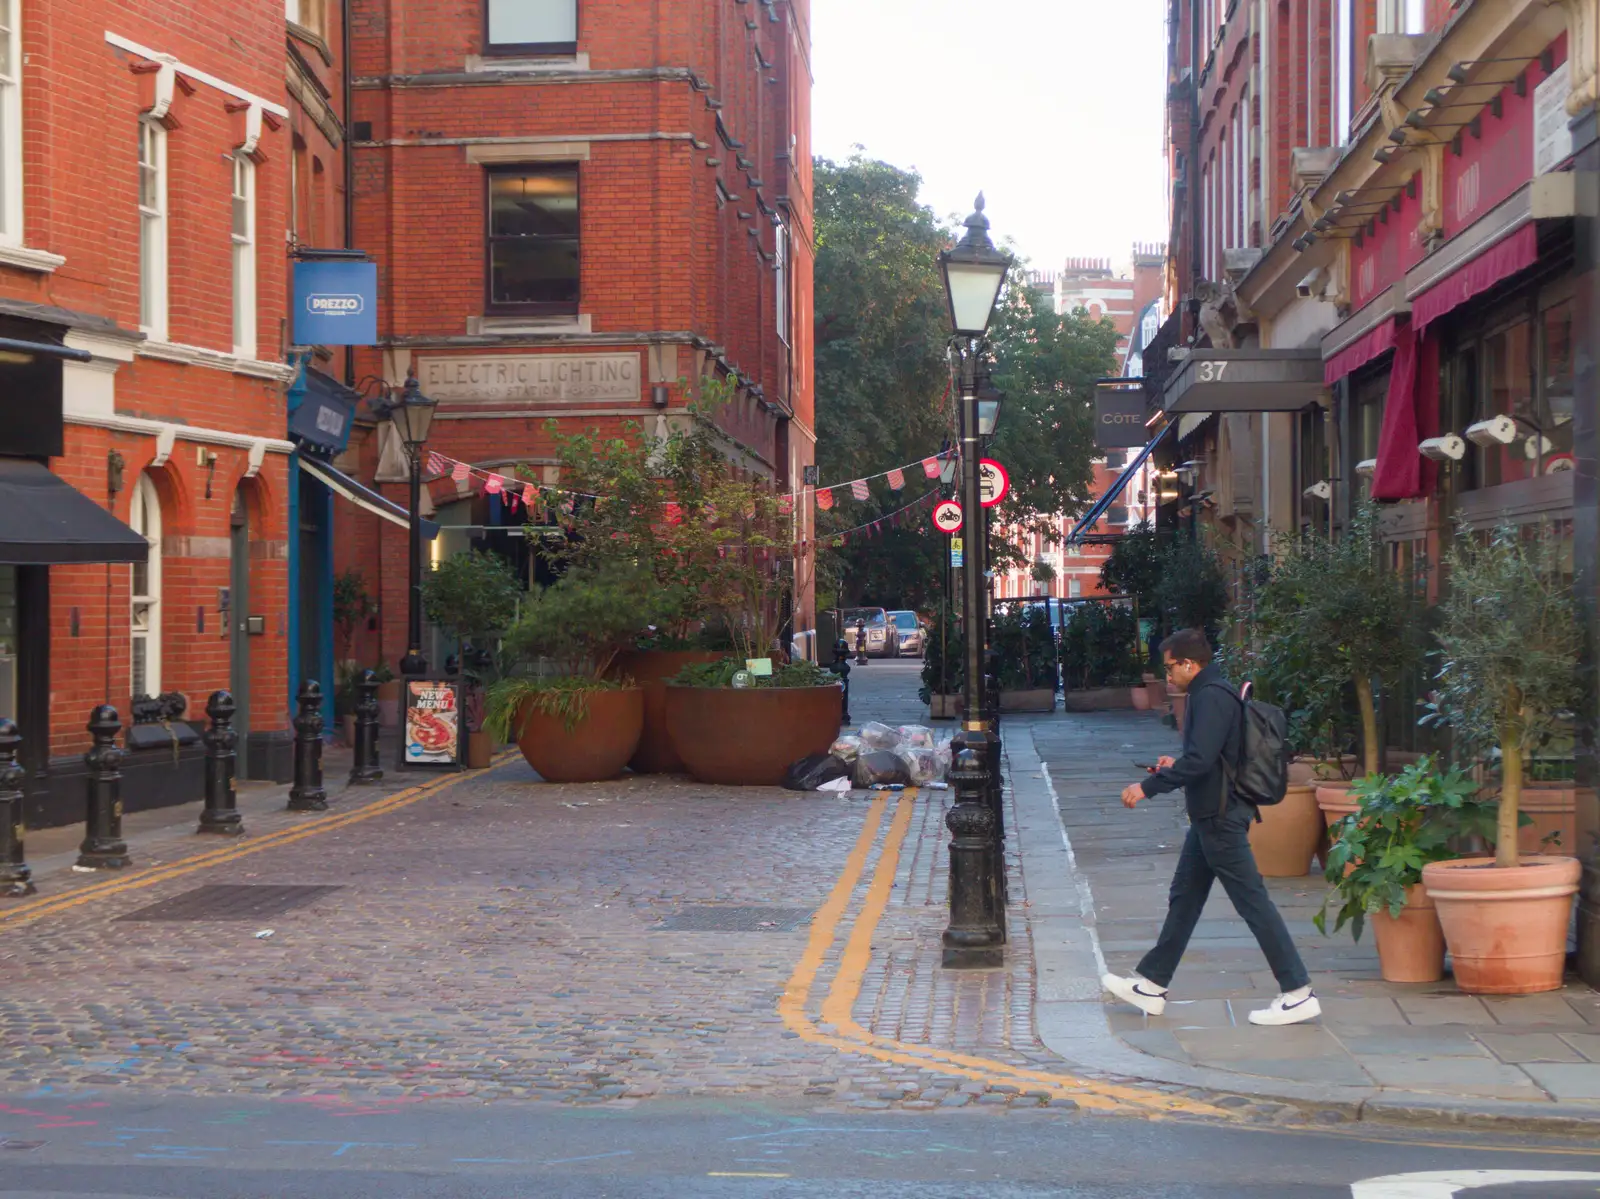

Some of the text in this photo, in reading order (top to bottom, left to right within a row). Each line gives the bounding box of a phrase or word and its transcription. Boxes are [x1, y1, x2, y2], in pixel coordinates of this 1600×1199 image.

[313, 298, 358, 309] PREZZO
[429, 360, 632, 385] ELECTRIC LIGHTING
[1200, 361, 1228, 382] 37
[507, 386, 560, 397] STATION
[1102, 412, 1141, 424] CÔTE
[420, 690, 445, 700] NEW
[416, 700, 449, 709] MENU
